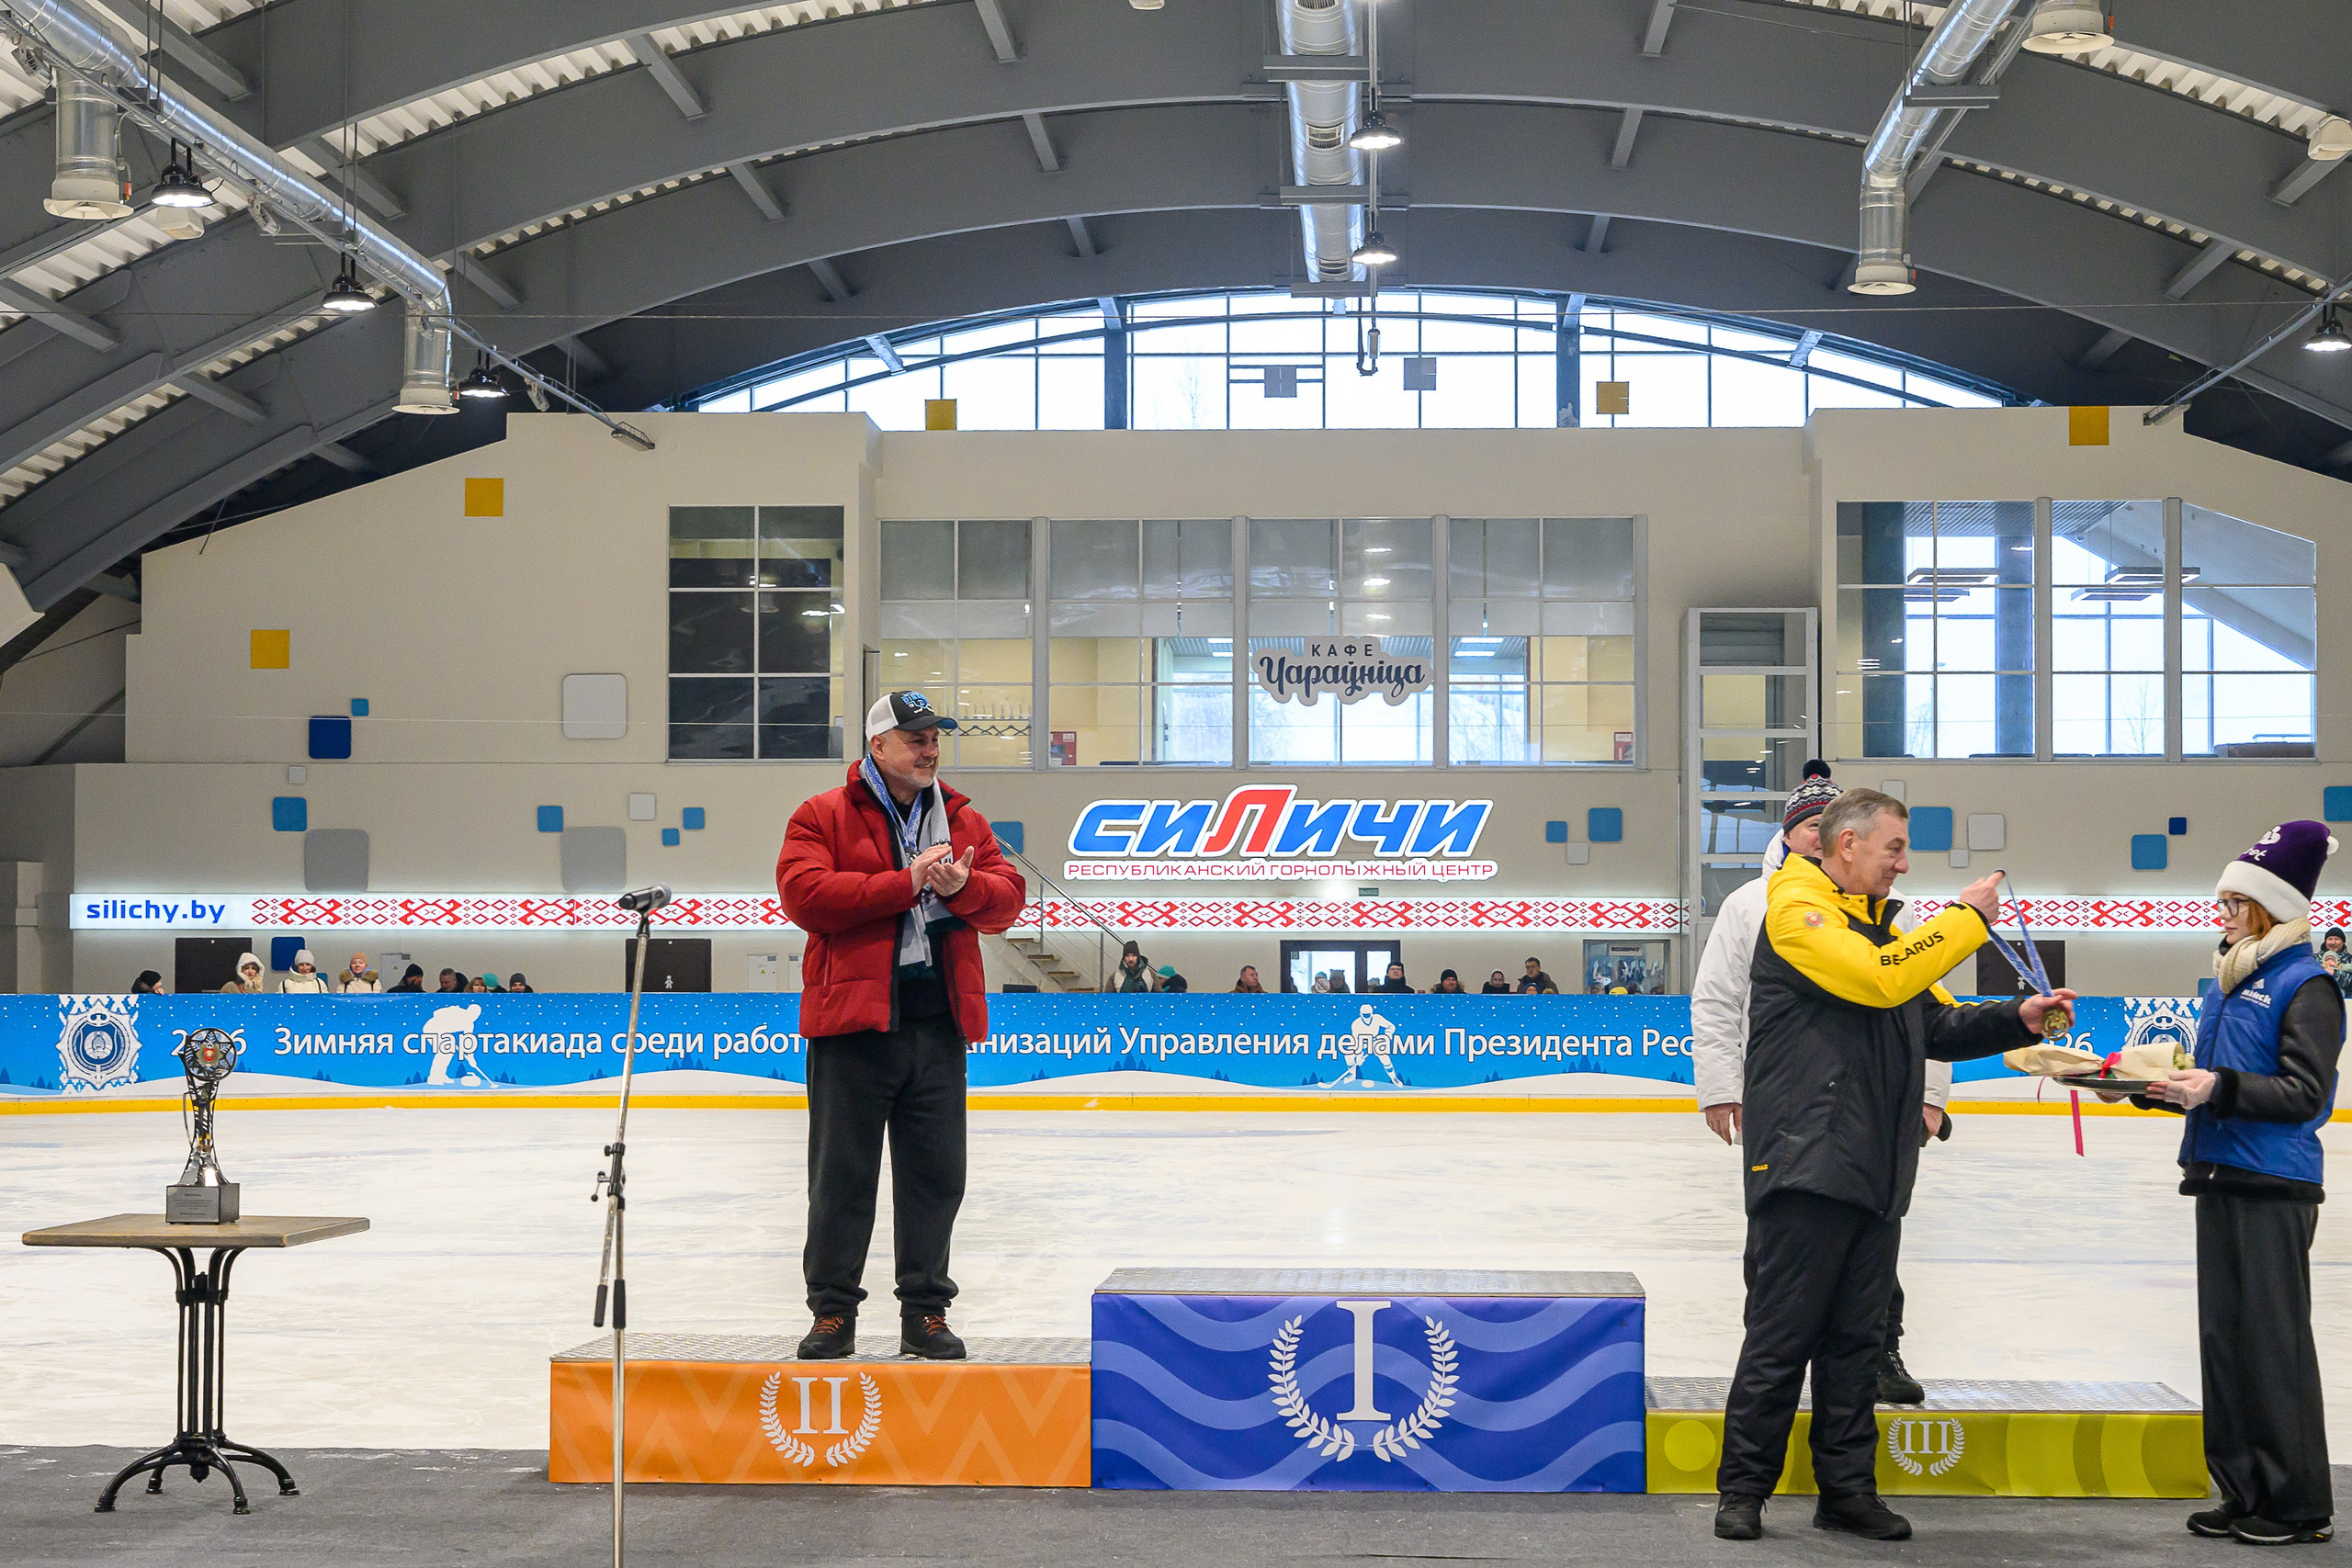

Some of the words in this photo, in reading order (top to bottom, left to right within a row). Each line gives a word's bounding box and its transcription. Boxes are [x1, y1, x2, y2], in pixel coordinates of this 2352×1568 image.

[1311, 644, 1373, 657] КАФЕ
[1259, 656, 1426, 698] Чараўніца
[1069, 860, 1266, 876] РЕСПУБЛИКАНСКИЙ
[1271, 860, 1427, 876] ГОРНОЛЫЖНЫЙ
[1431, 864, 1494, 878] ЦЕНТР
[86, 899, 226, 924] silichy.by
[171, 1027, 247, 1056] 26
[274, 1027, 394, 1055] Зимняя
[402, 1032, 603, 1061] спартакиада
[610, 1032, 705, 1059] среди
[713, 1024, 808, 1061] работ
[1118, 1026, 1310, 1061] Управления
[1317, 1033, 1435, 1060] делами
[1444, 1028, 1633, 1062] Президента
[1642, 1028, 1694, 1056] Рес
[1336, 1300, 1392, 1421] I
[791, 1376, 850, 1435] II
[1900, 1420, 1955, 1454] III
